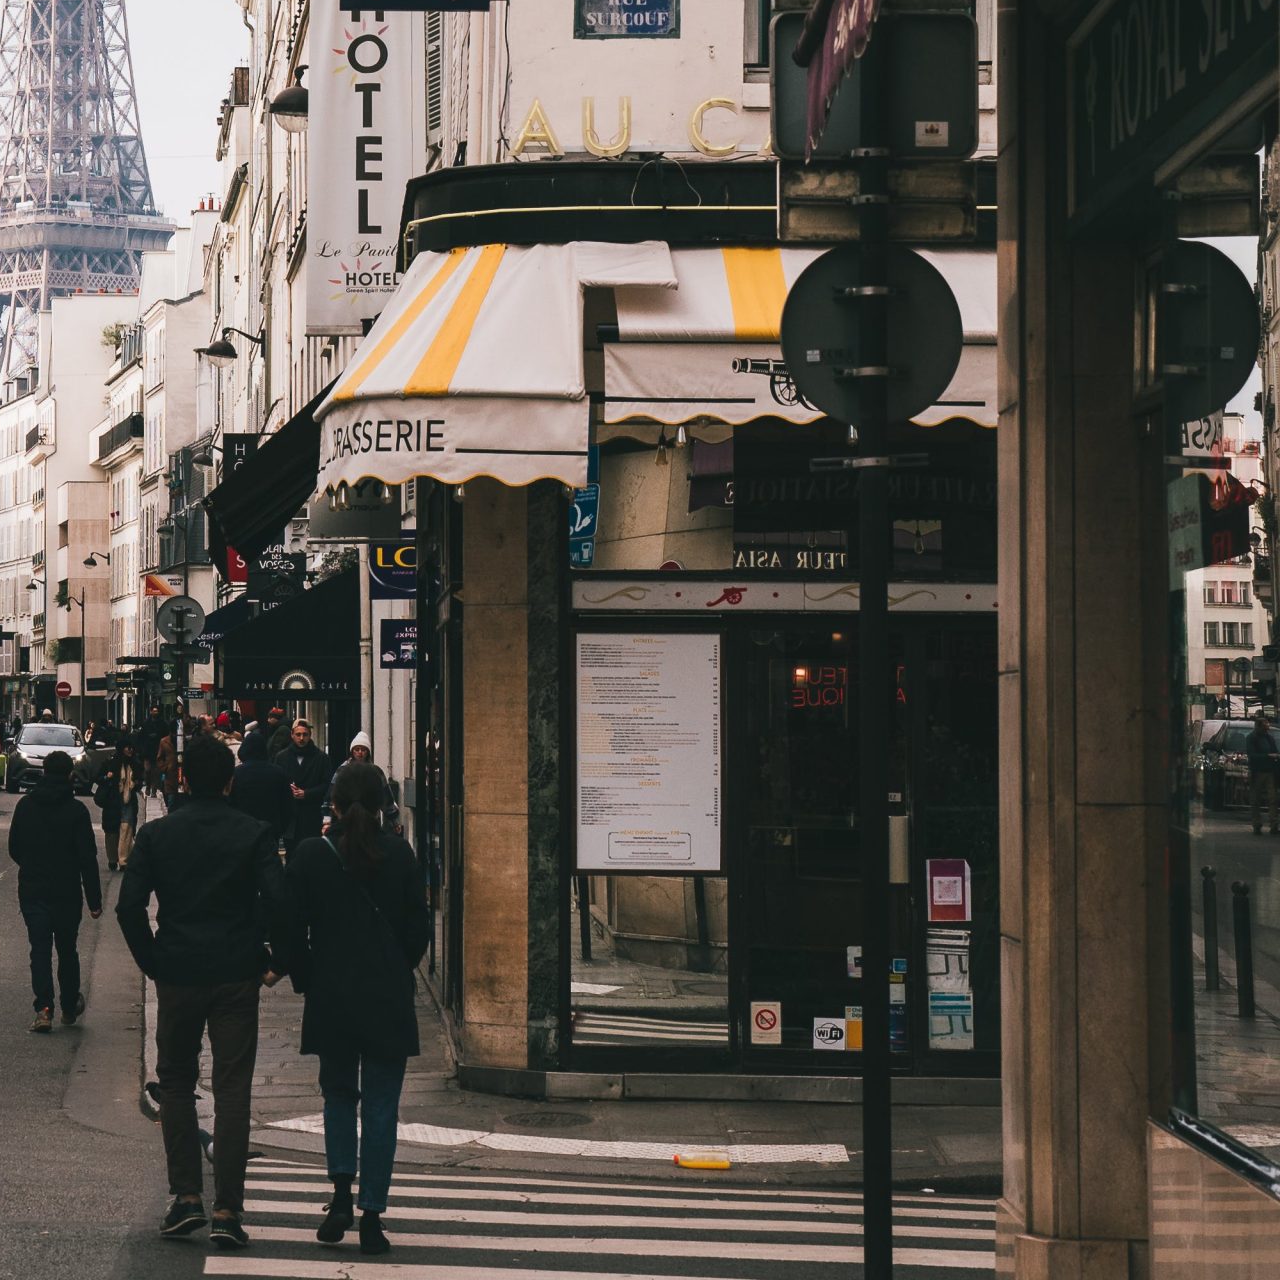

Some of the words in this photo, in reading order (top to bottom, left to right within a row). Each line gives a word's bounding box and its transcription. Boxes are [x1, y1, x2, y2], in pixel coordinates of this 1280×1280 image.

[586, 12, 669, 26] SURCOUF
[347, 10, 388, 234] OTEL
[508, 95, 632, 158] AU
[687, 96, 772, 158] C
[314, 239, 341, 258] Le
[345, 272, 400, 287] HOTEL
